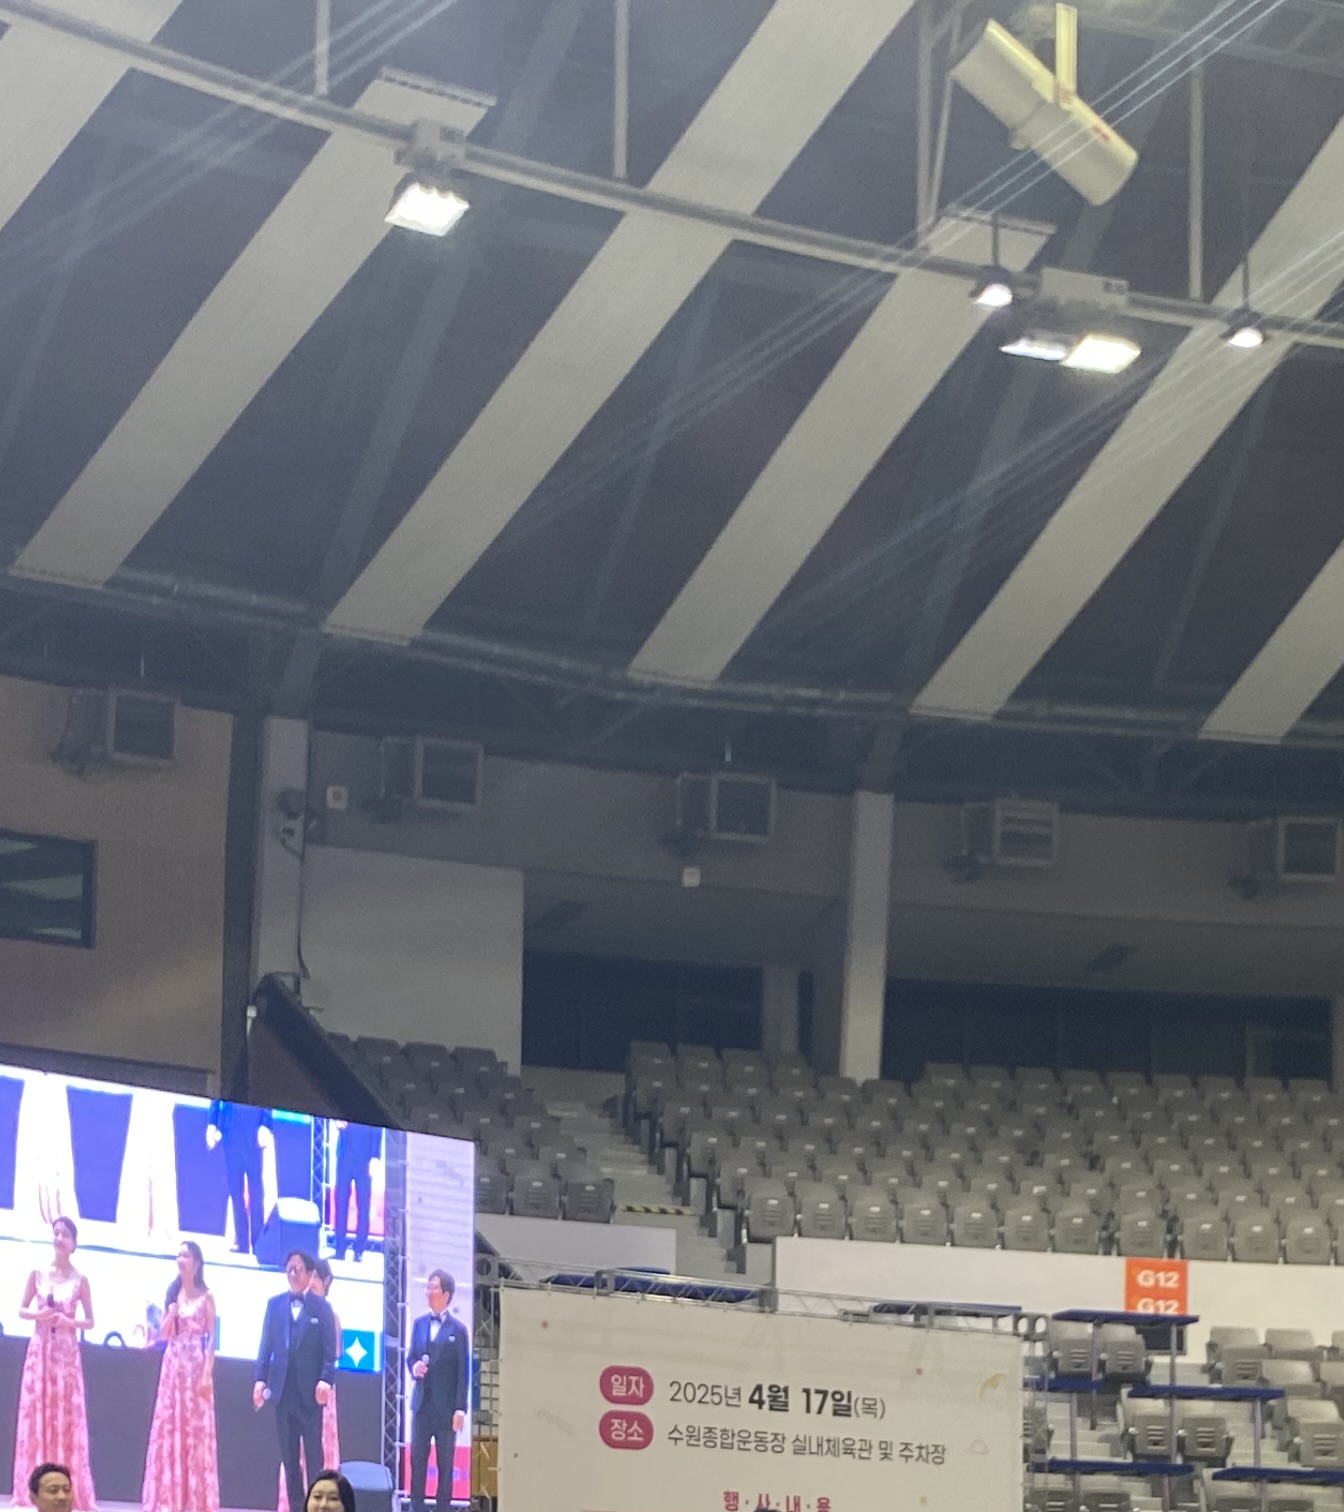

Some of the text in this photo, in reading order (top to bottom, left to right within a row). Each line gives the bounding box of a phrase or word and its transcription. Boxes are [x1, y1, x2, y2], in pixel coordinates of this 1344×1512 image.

[1137, 1269, 1180, 1289] G12
[610, 1373, 887, 1420] 일자 2025년 4월 17일(목)
[610, 1417, 947, 1466] 장소 수원종합운동장 실내체육관 및 주차장
